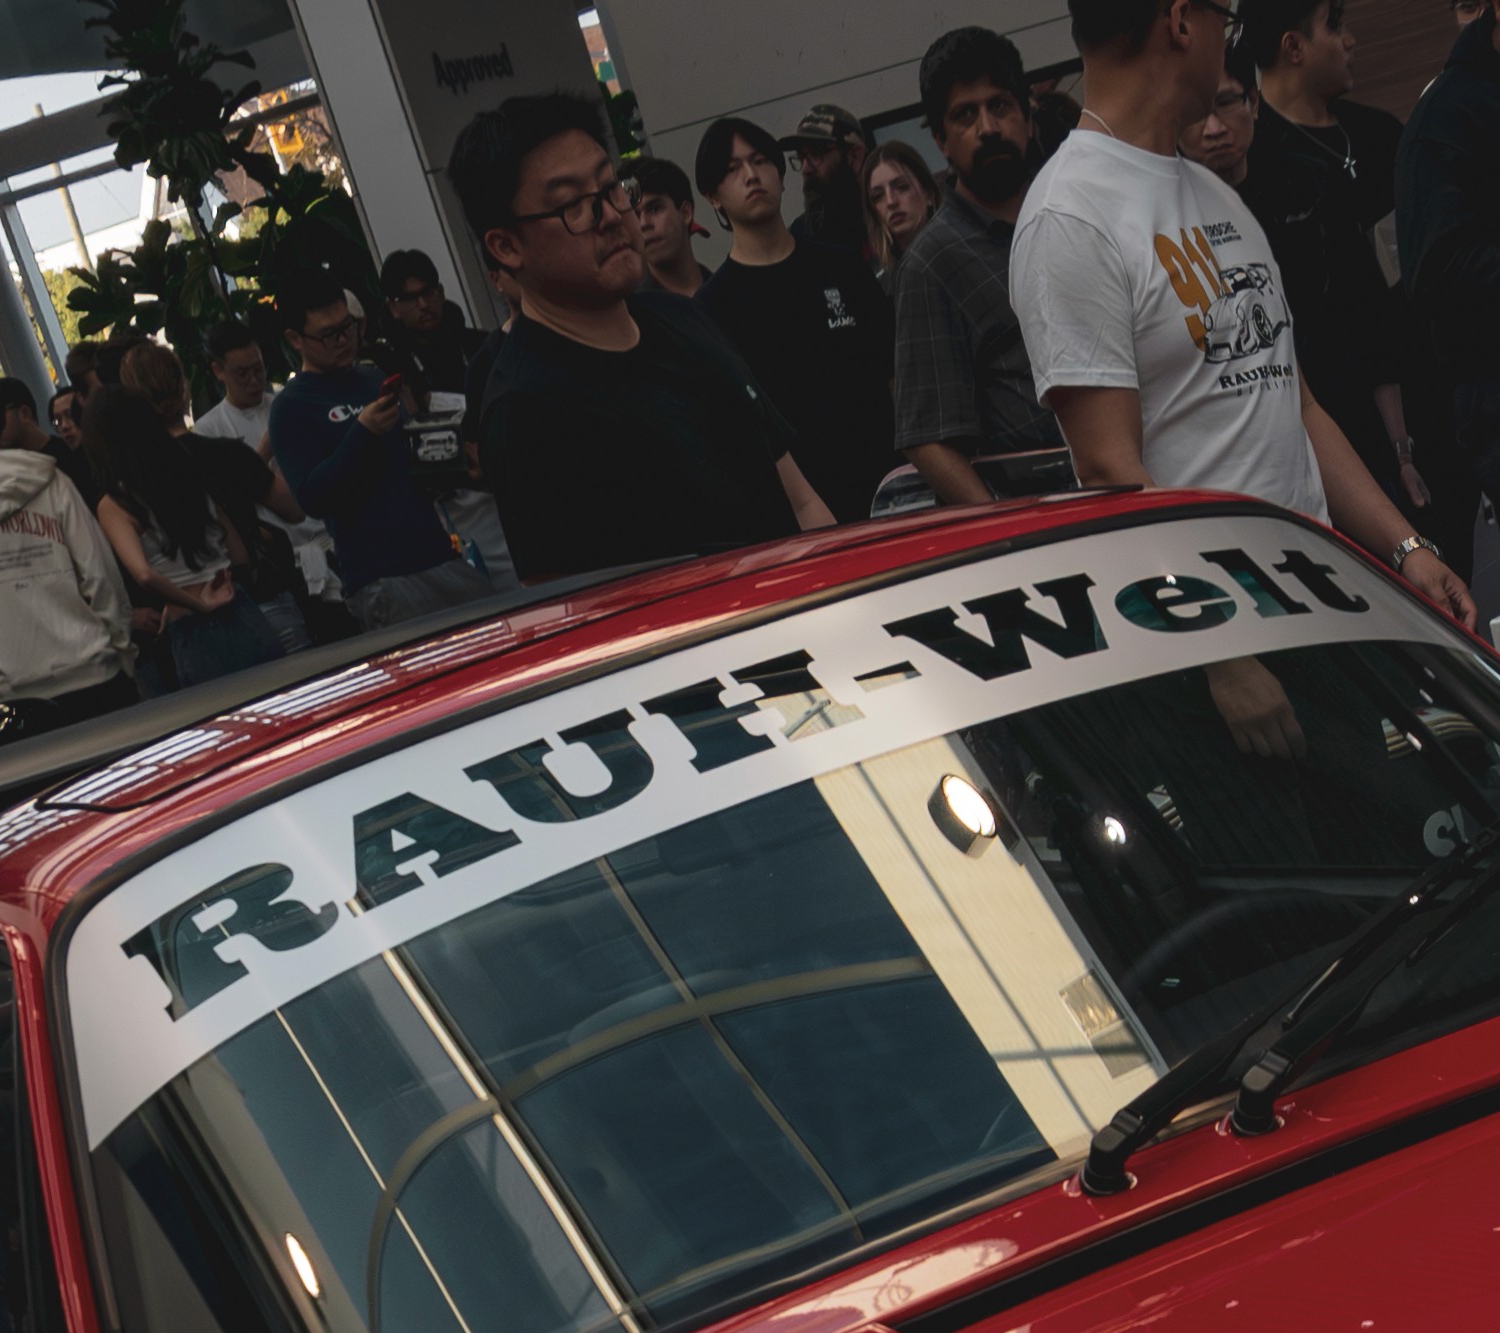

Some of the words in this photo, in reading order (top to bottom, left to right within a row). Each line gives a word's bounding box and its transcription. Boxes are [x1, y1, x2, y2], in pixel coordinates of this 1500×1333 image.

[432, 42, 514, 95] Approved
[1154, 226, 1233, 353] 911
[121, 547, 1371, 1023] RAUH-Welt
